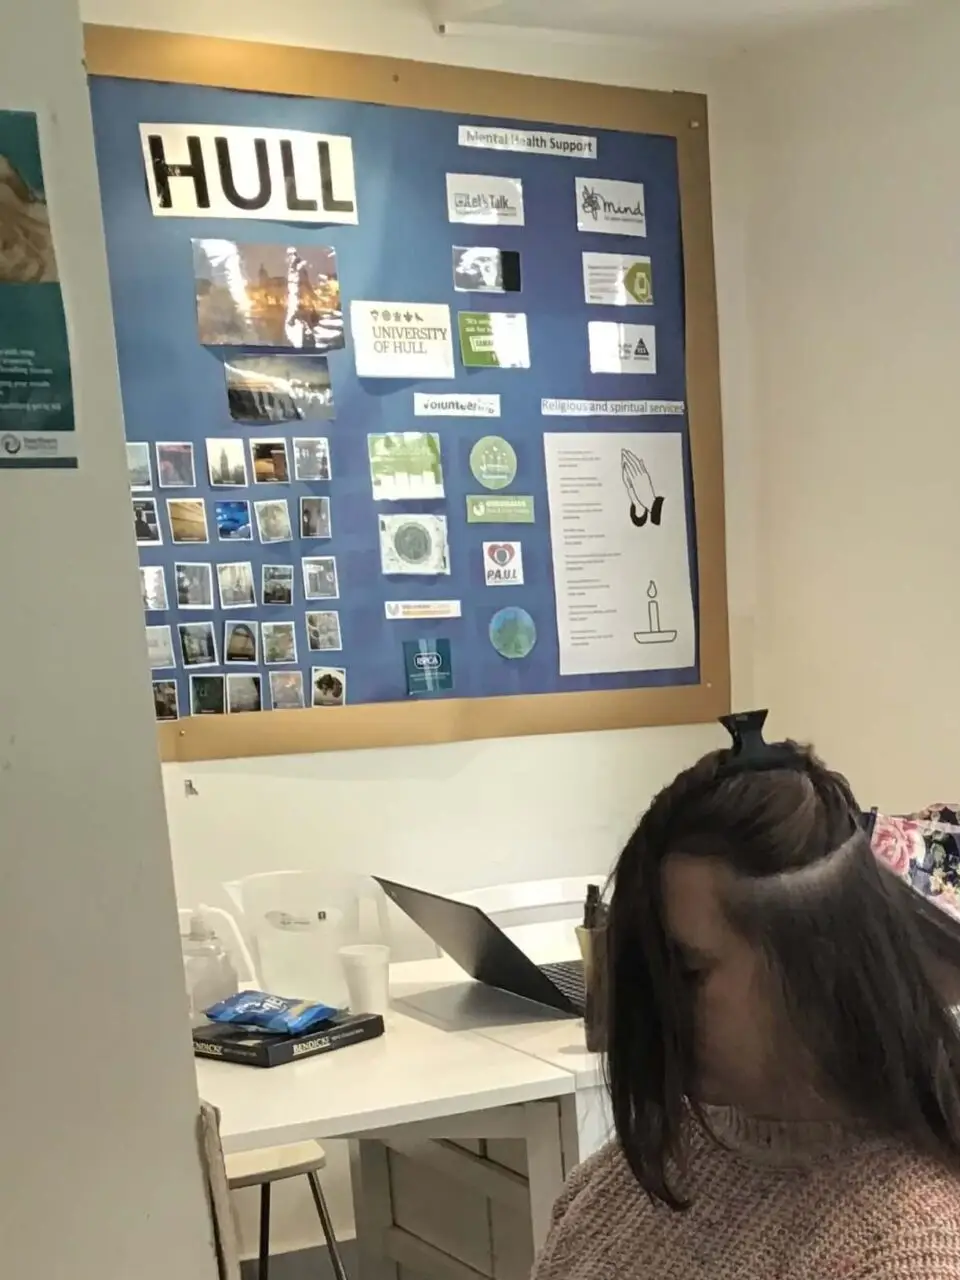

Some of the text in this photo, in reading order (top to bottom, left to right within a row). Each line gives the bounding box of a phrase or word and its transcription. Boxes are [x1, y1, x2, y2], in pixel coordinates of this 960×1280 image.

[466, 130, 507, 144] Mental
[549, 137, 593, 152] Support
[148, 134, 354, 212] HULL
[371, 325, 447, 340] UNIVERSITY
[373, 340, 427, 354] OF HULL
[423, 399, 495, 414] Volunteer
[542, 400, 684, 415] Religious and spiritual services
